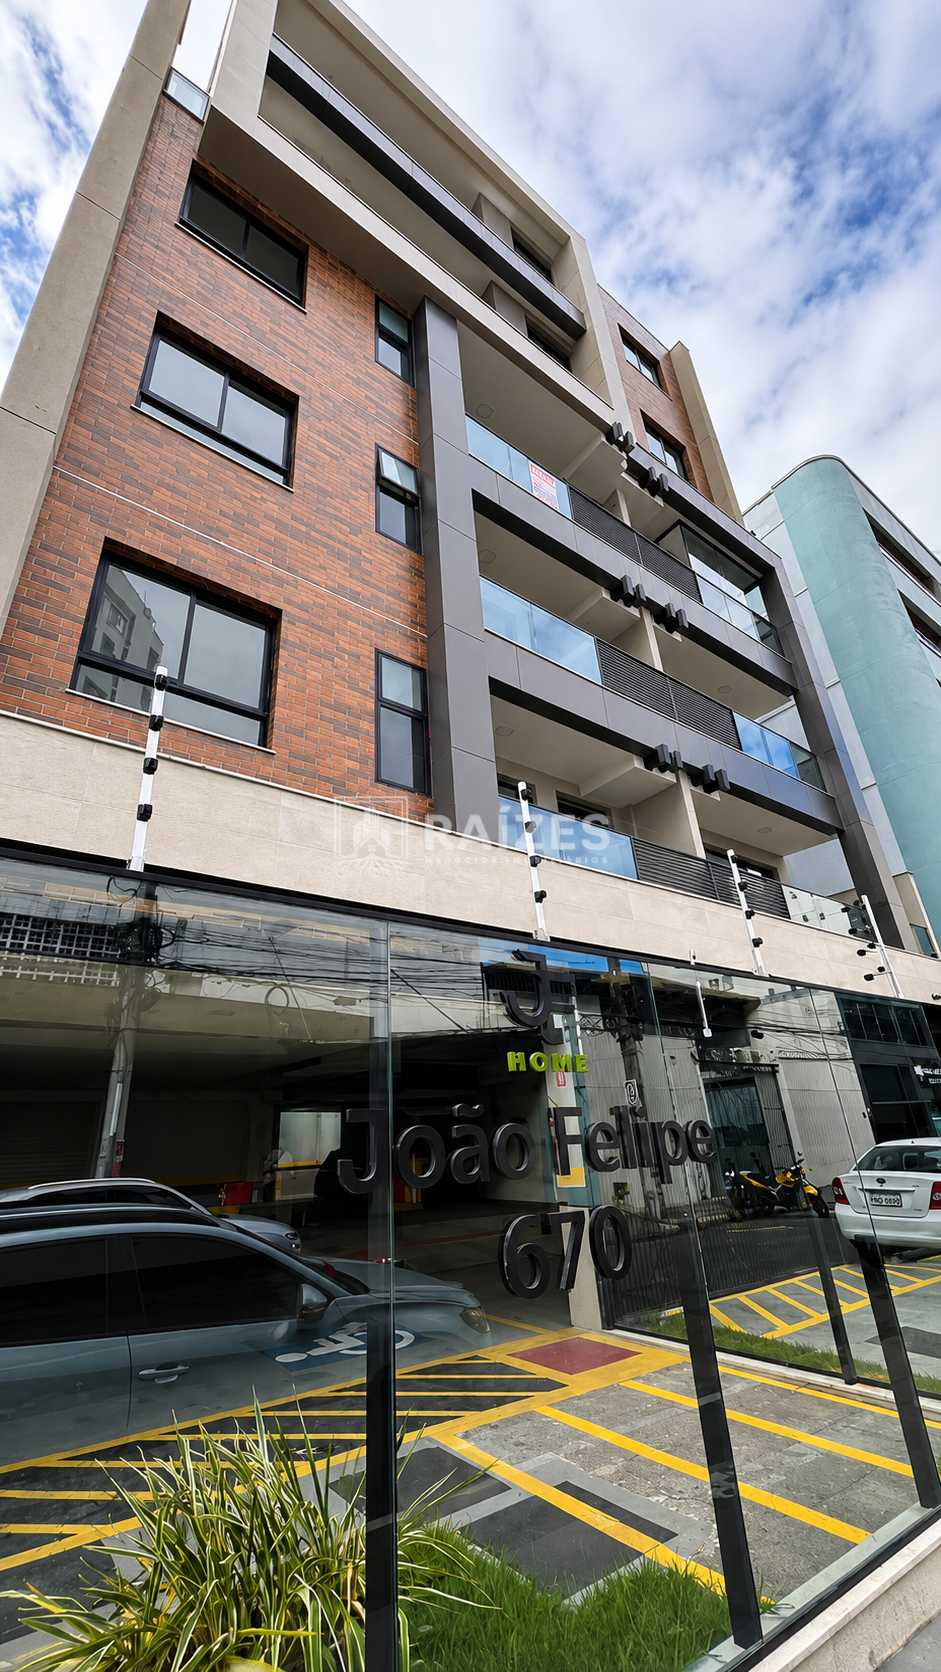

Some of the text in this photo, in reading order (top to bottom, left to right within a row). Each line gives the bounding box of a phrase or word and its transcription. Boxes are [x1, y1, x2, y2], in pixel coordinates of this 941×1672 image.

[507, 1051, 589, 1073] HOME
[337, 1104, 718, 1194] João Felipe
[500, 1205, 632, 1299] 670
